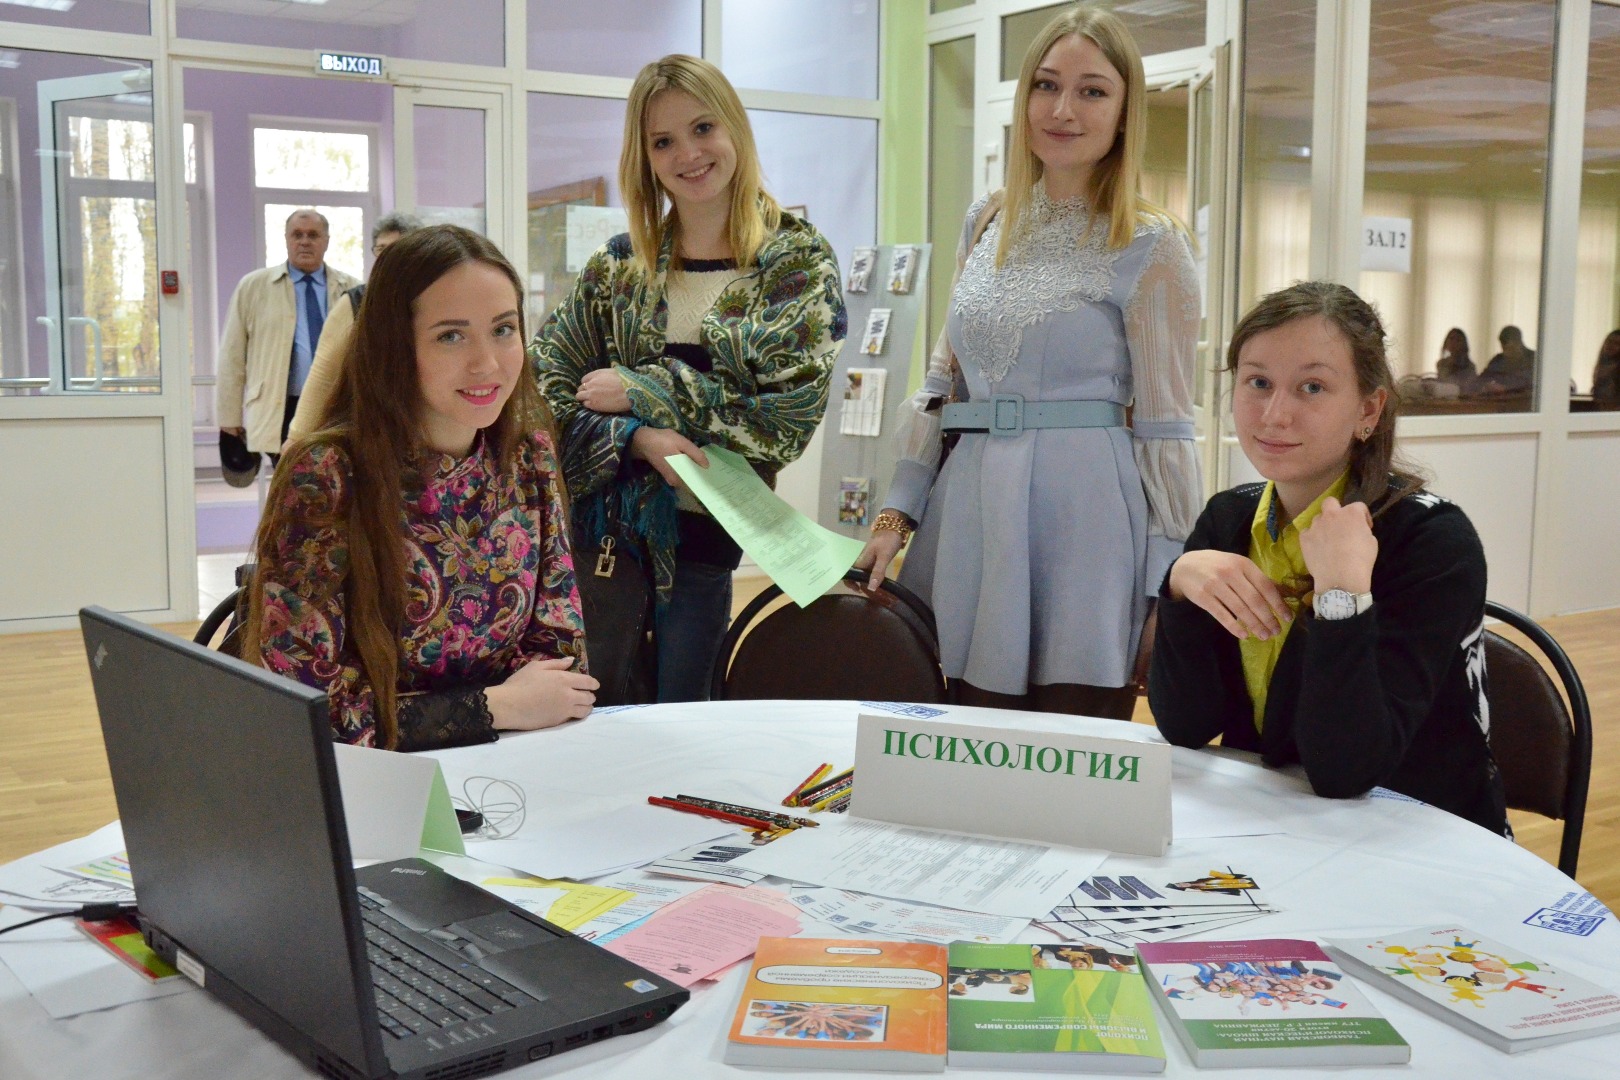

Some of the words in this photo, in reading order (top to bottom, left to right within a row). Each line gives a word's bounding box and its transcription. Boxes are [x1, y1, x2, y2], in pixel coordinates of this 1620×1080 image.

[321, 54, 380, 75] ВЫХОД
[881, 729, 1142, 783] ПСИХОЛОГИЯ
[1089, 1024, 1138, 1034] ВЫЗОВЫ
[1095, 1031, 1148, 1041] ПСИХОЛОГ
[1287, 1034, 1361, 1042] ТАМБОВСКАЯ
